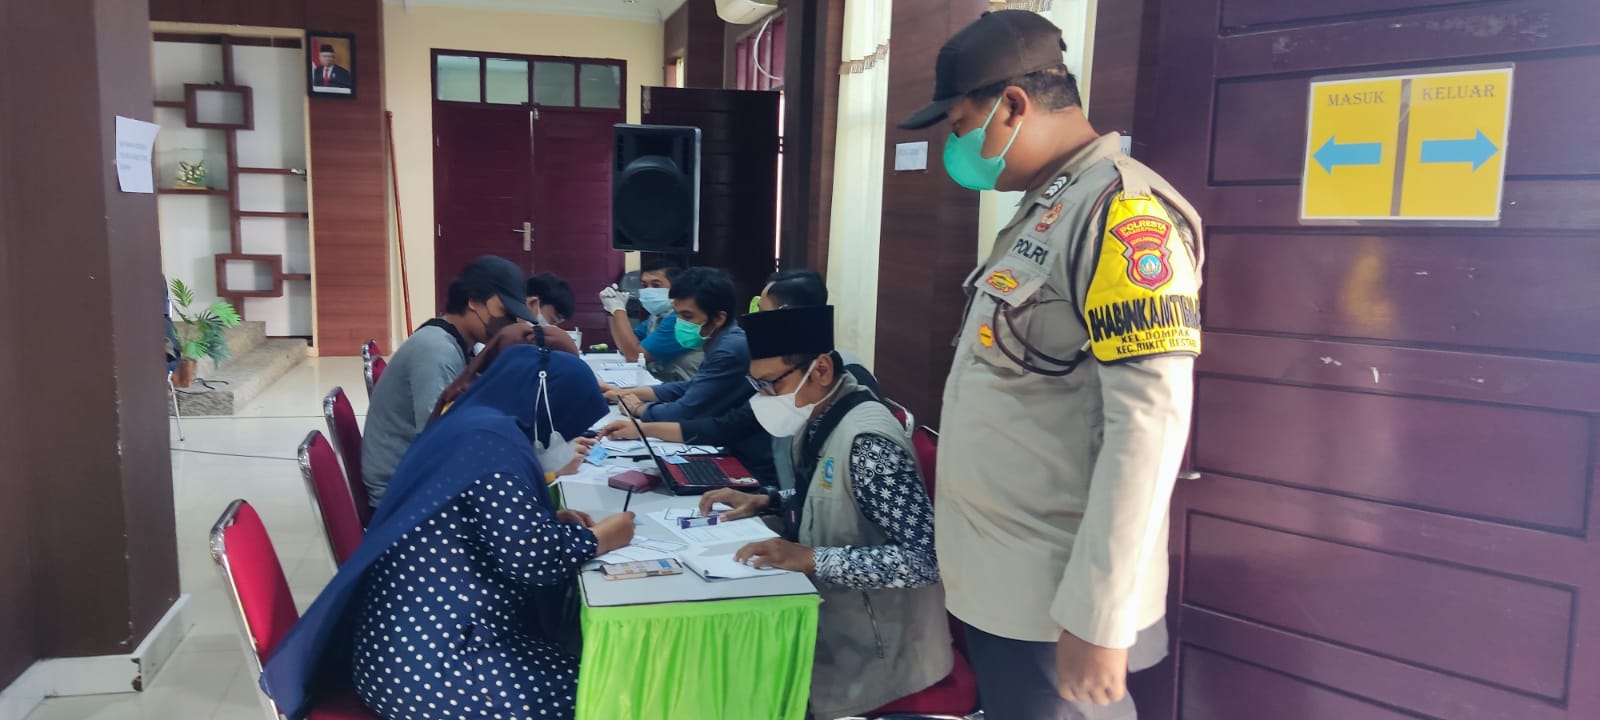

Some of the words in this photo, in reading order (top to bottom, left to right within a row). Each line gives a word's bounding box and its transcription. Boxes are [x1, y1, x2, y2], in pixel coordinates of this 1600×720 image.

[1327, 91, 1385, 106] MASUK
[1422, 84, 1496, 100] KELUAR
[1012, 238, 1049, 266] POLRI
